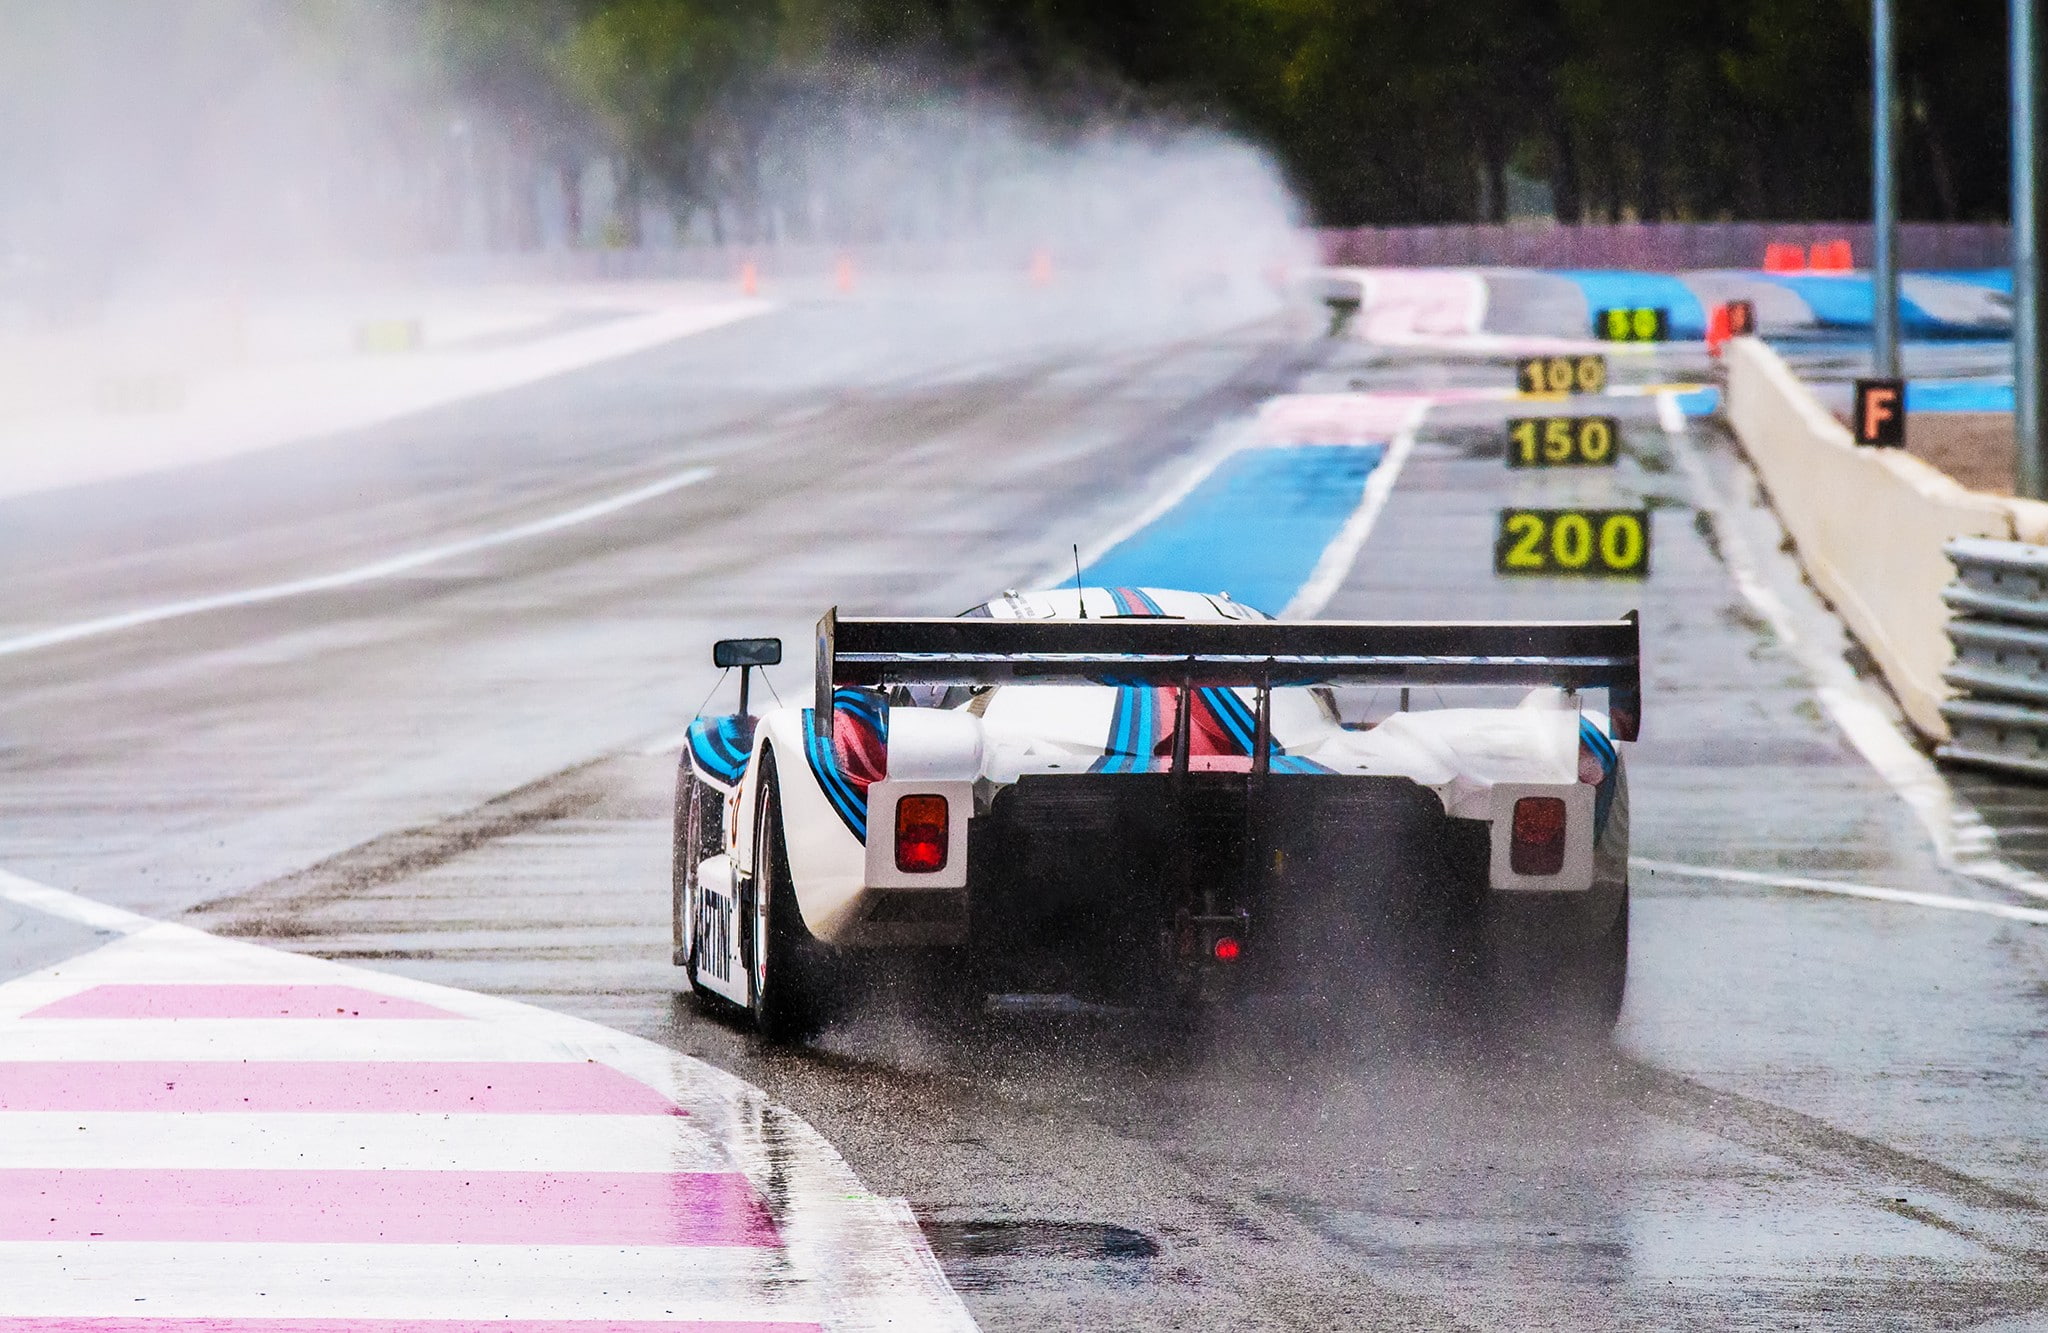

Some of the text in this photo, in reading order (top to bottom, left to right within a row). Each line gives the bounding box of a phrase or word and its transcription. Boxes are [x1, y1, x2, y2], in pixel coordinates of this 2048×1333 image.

[1526, 357, 1604, 391] 100
[1512, 419, 1610, 461] 150
[1865, 388, 1896, 440] F
[1505, 513, 1643, 569] 200
[696, 886, 730, 983] ARTINI
